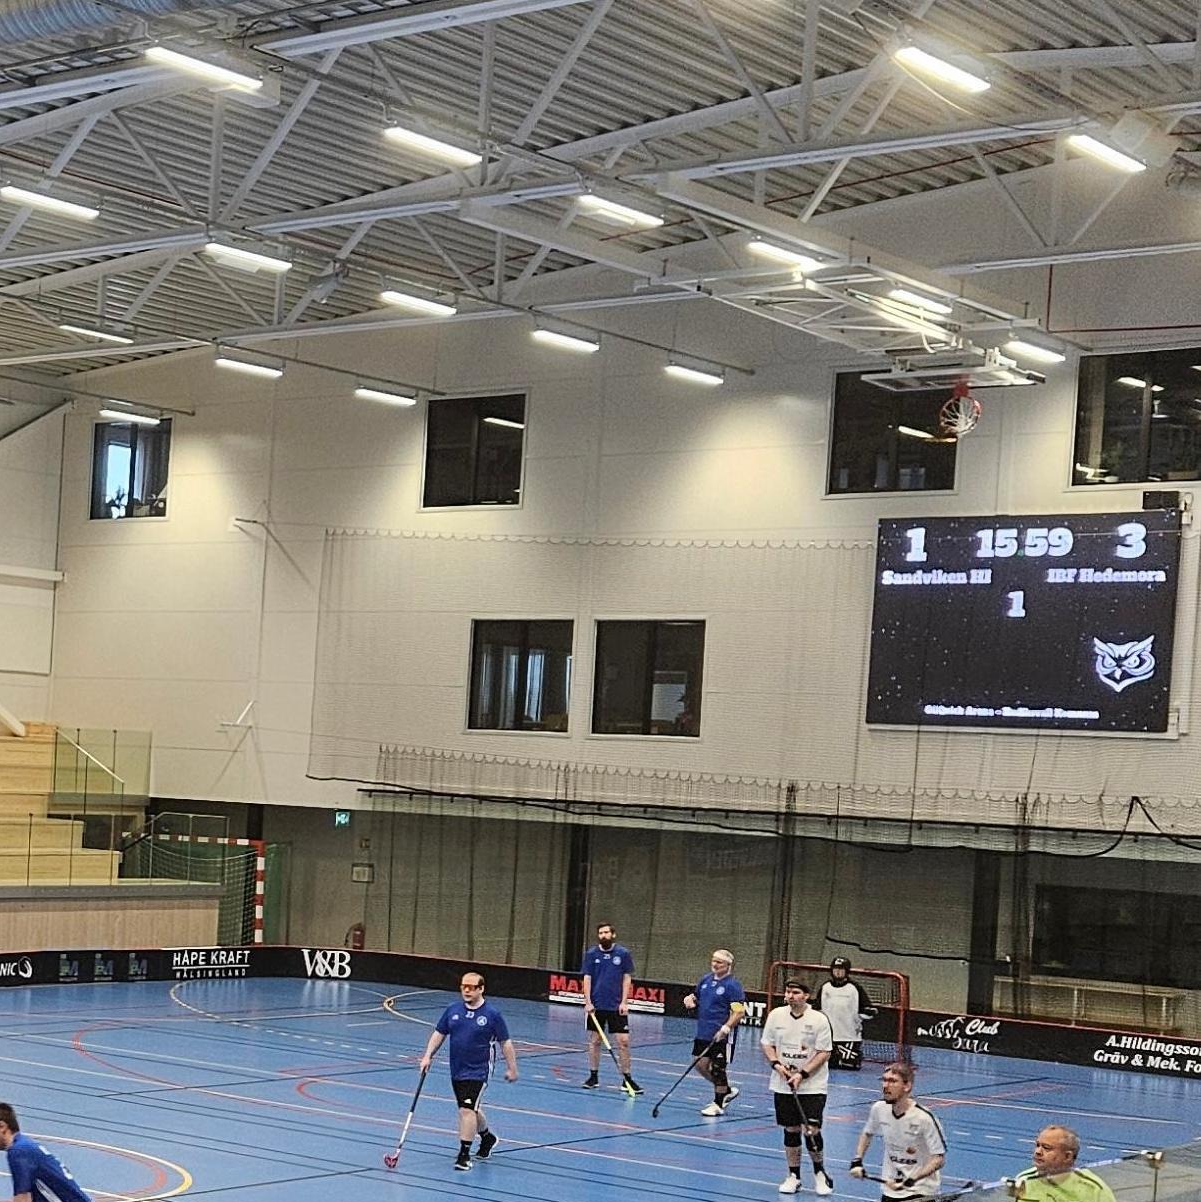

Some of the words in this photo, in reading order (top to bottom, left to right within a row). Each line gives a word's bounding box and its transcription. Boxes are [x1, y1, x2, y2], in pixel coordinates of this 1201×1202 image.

[904, 526, 928, 562] 1
[1114, 522, 1148, 559] 3
[881, 569, 968, 585] Sandviken
[1006, 590, 1026, 618] 1
[210, 950, 251, 965] KRAFT
[1105, 1034, 1201, 1057] A.Hildingsso
[1093, 1049, 1129, 1065] Gräv
[1130, 1053, 1144, 1067] &
